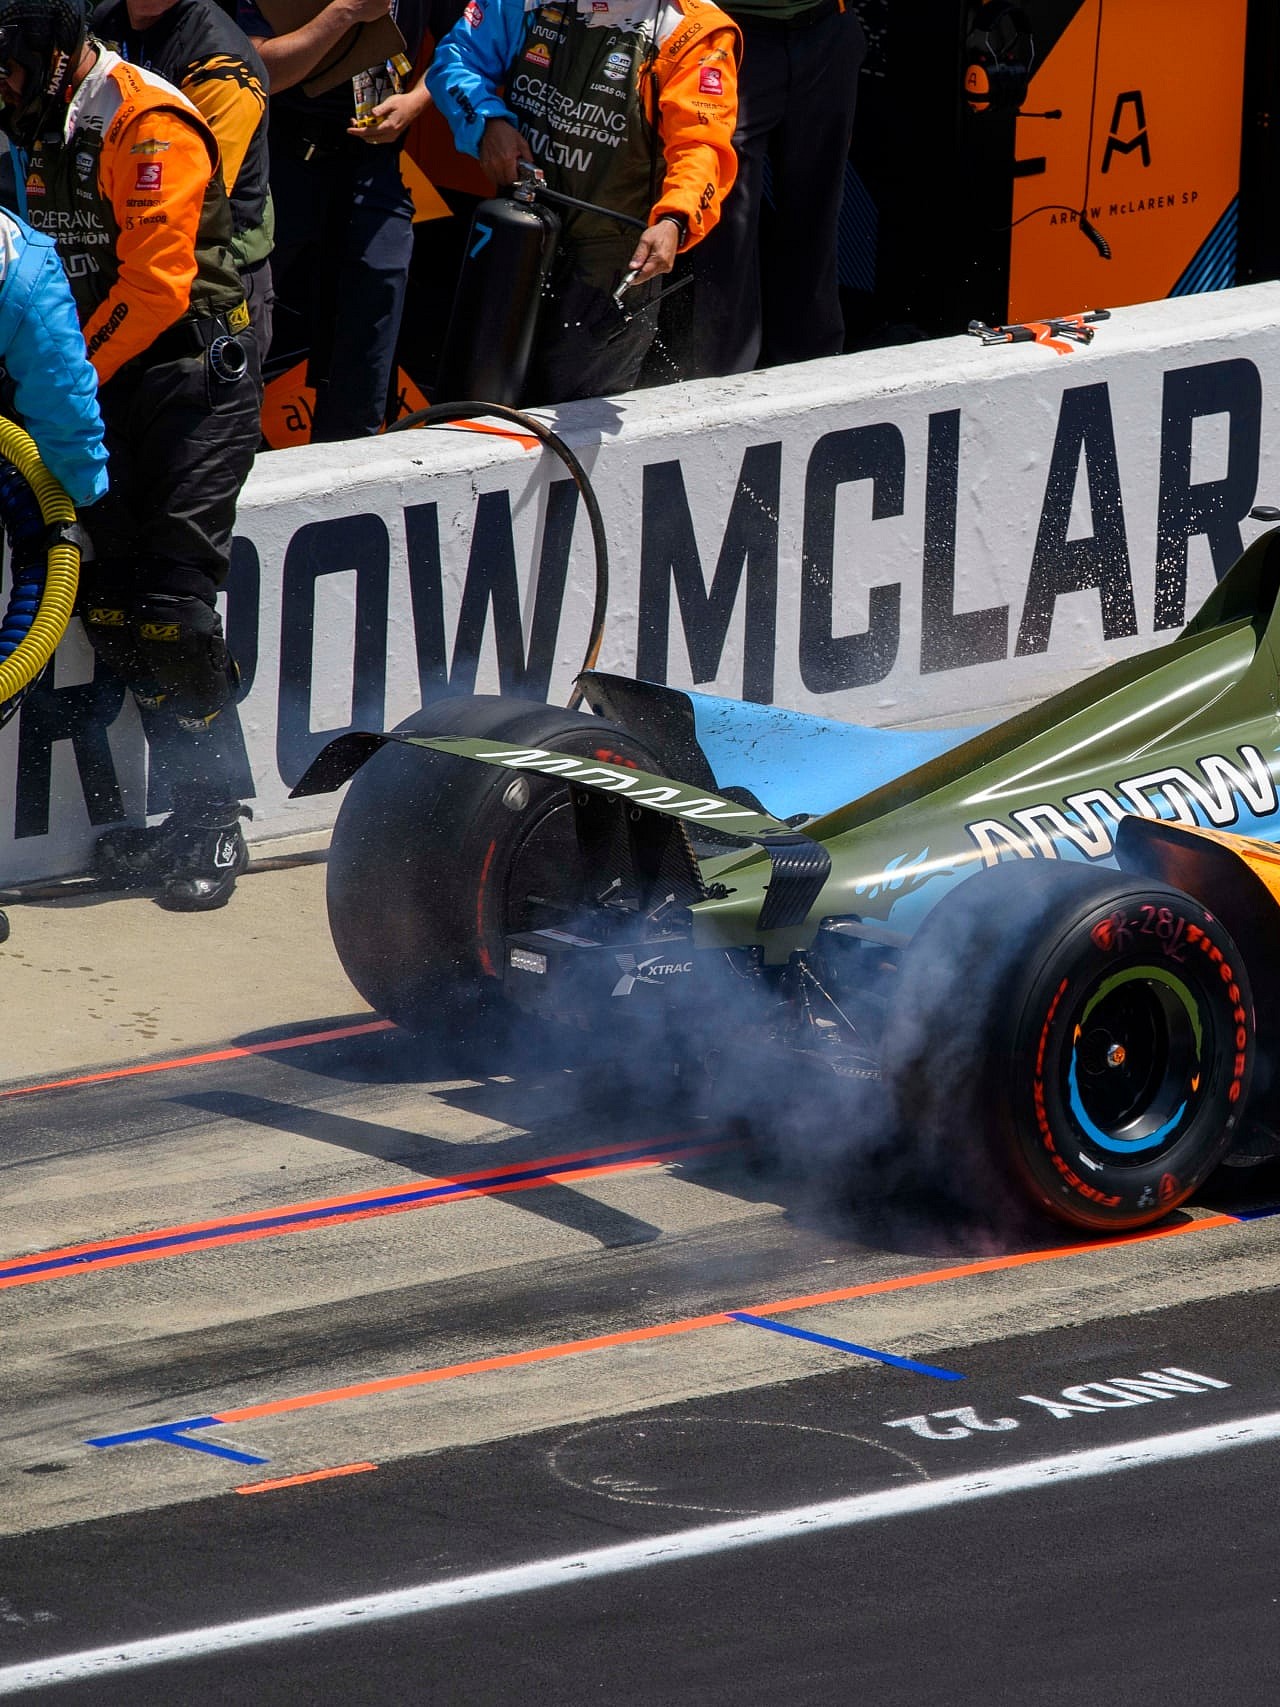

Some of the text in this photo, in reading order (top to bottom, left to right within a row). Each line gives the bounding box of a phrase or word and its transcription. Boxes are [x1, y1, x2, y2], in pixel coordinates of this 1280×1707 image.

[47, 51, 71, 96] MARTY
[590, 83, 615, 95] LUCAS
[1109, 194, 1175, 217] McLAREN
[1182, 191, 1199, 204] SP
[469, 222, 493, 258] 7
[648, 961, 693, 976] XTRAC
[882, 1367, 1233, 1440] INDY 22
